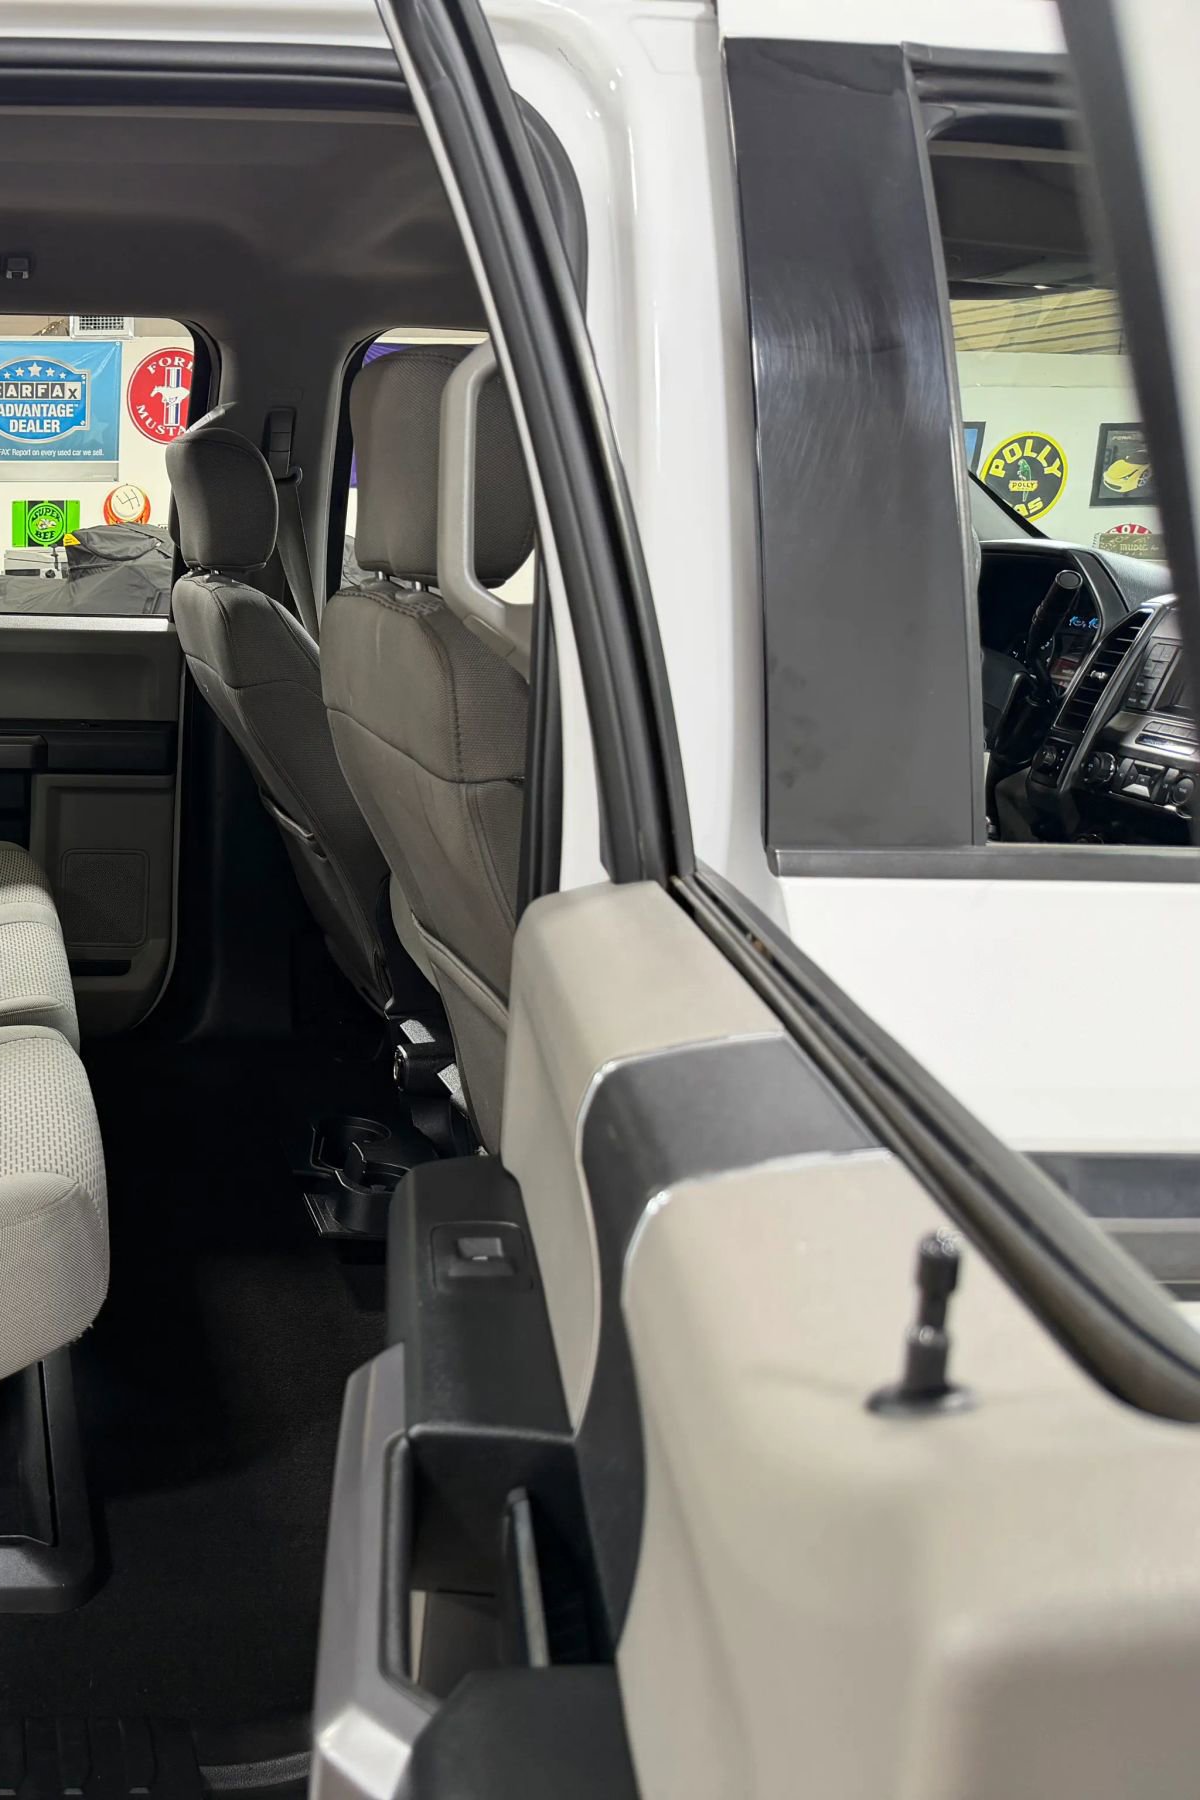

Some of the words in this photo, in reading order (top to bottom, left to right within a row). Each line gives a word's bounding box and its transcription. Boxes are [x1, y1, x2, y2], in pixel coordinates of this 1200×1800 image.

[9, 419, 61, 433] DEALER
[12, 448, 31, 457] Report
[40, 450, 56, 458] every
[92, 449, 104, 457] sell.
[989, 439, 1062, 478] POLLY
[1003, 497, 1043, 516] AS
[32, 507, 61, 522] SUPER
[35, 530, 56, 540] BEE
